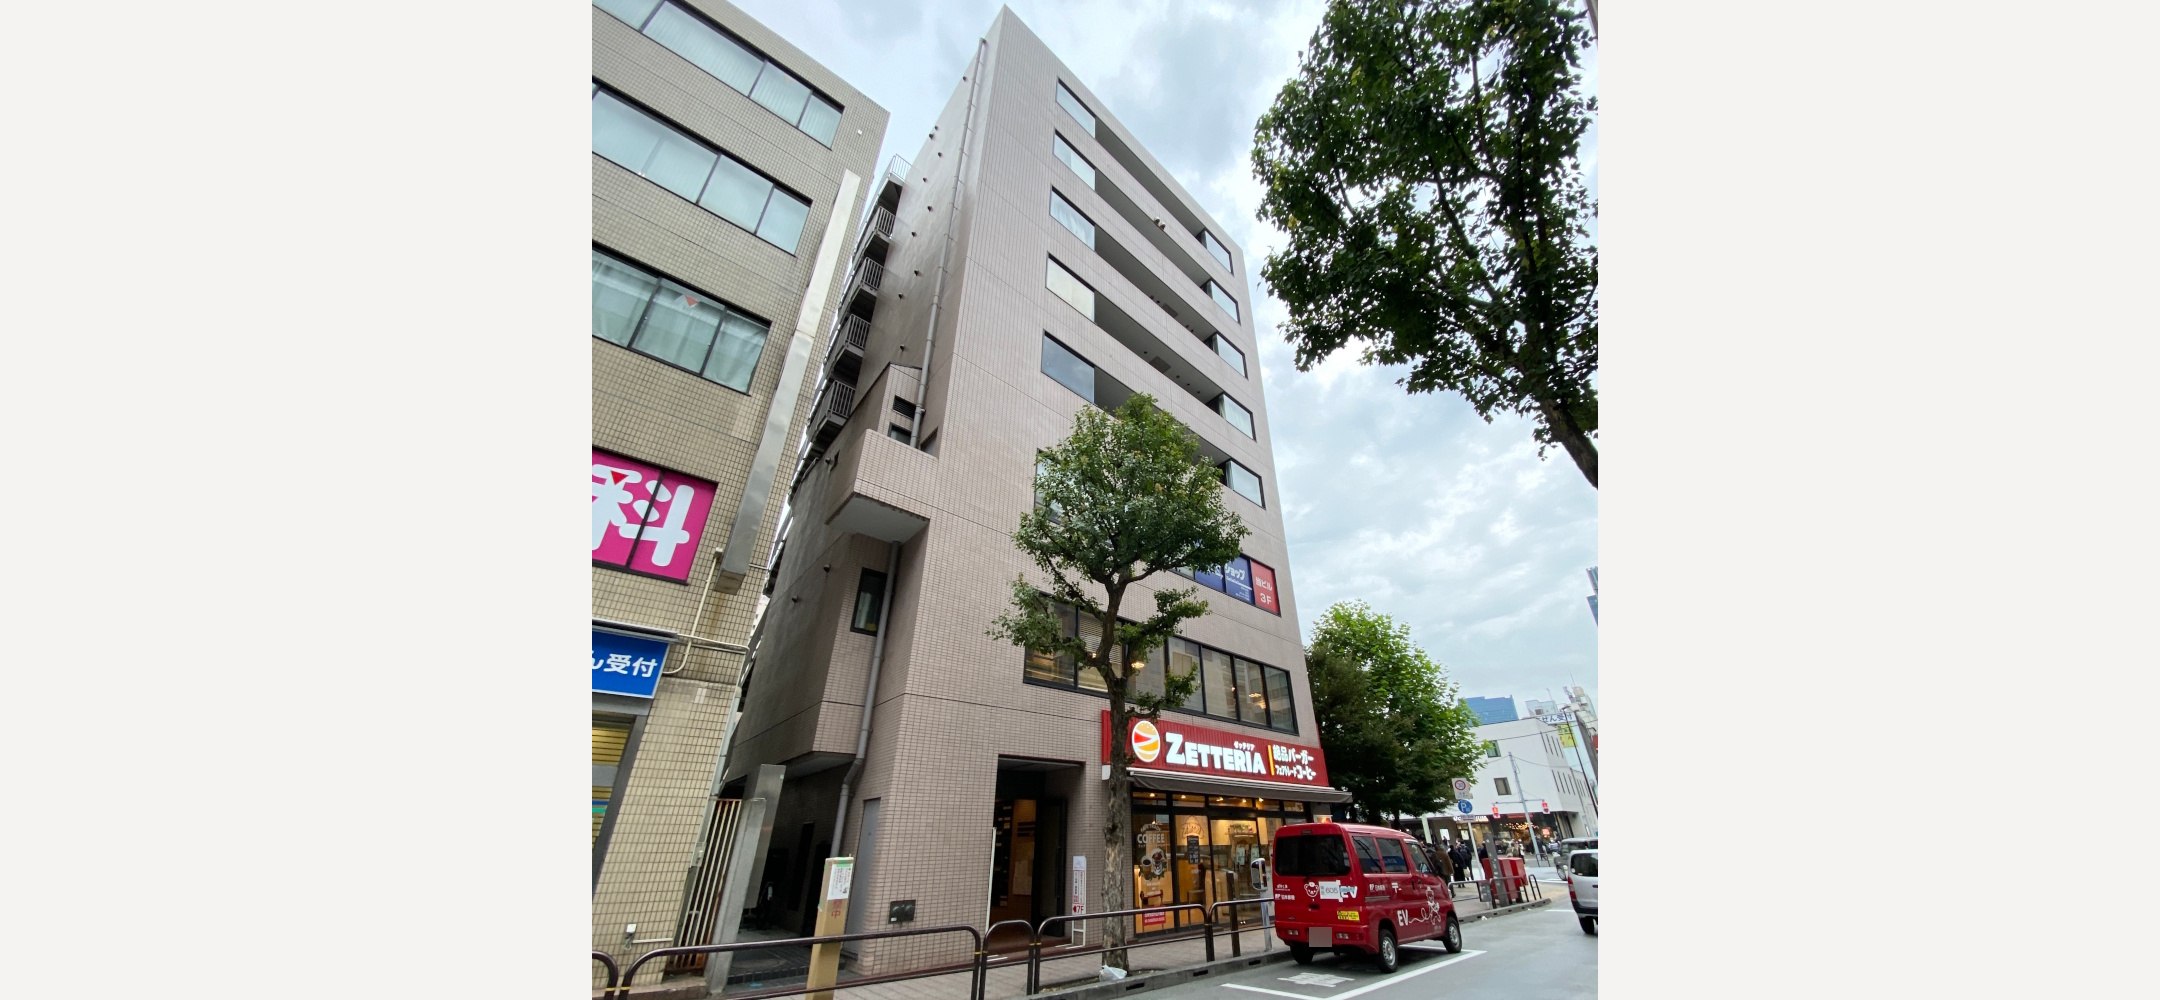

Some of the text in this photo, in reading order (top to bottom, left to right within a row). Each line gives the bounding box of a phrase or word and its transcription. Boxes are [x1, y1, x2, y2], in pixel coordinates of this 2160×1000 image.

[1260, 593, 1272, 604] 3F
[1165, 732, 1266, 774] ZETTERIA
[1272, 744, 1314, 765] 絶品バーガー
[1137, 833, 1165, 843] COFFEE
[1397, 909, 1408, 926] EV
